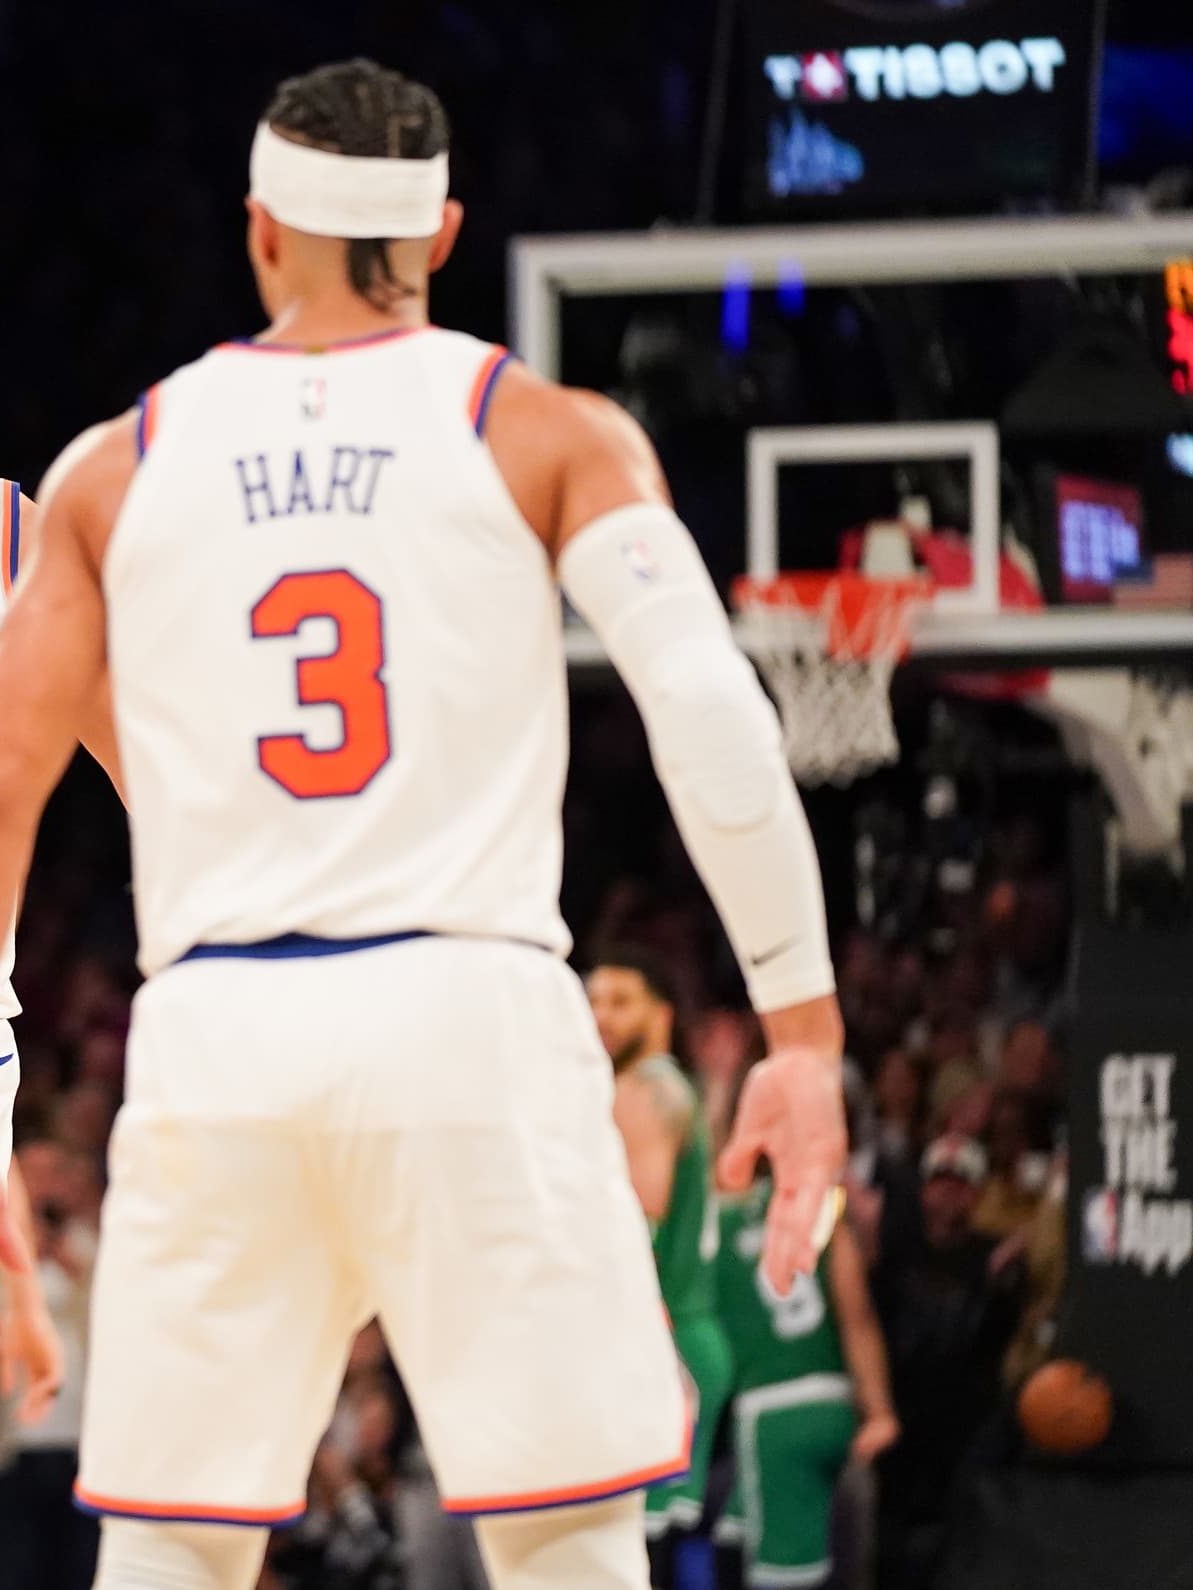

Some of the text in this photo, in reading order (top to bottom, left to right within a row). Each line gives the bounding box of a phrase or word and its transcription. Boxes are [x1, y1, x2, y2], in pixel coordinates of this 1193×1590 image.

[843, 37, 1065, 101] TISSOT
[235, 446, 395, 524] HART
[250, 567, 392, 800] 3
[1100, 1054, 1175, 1120] GET
[1100, 1119, 1178, 1191] THE
